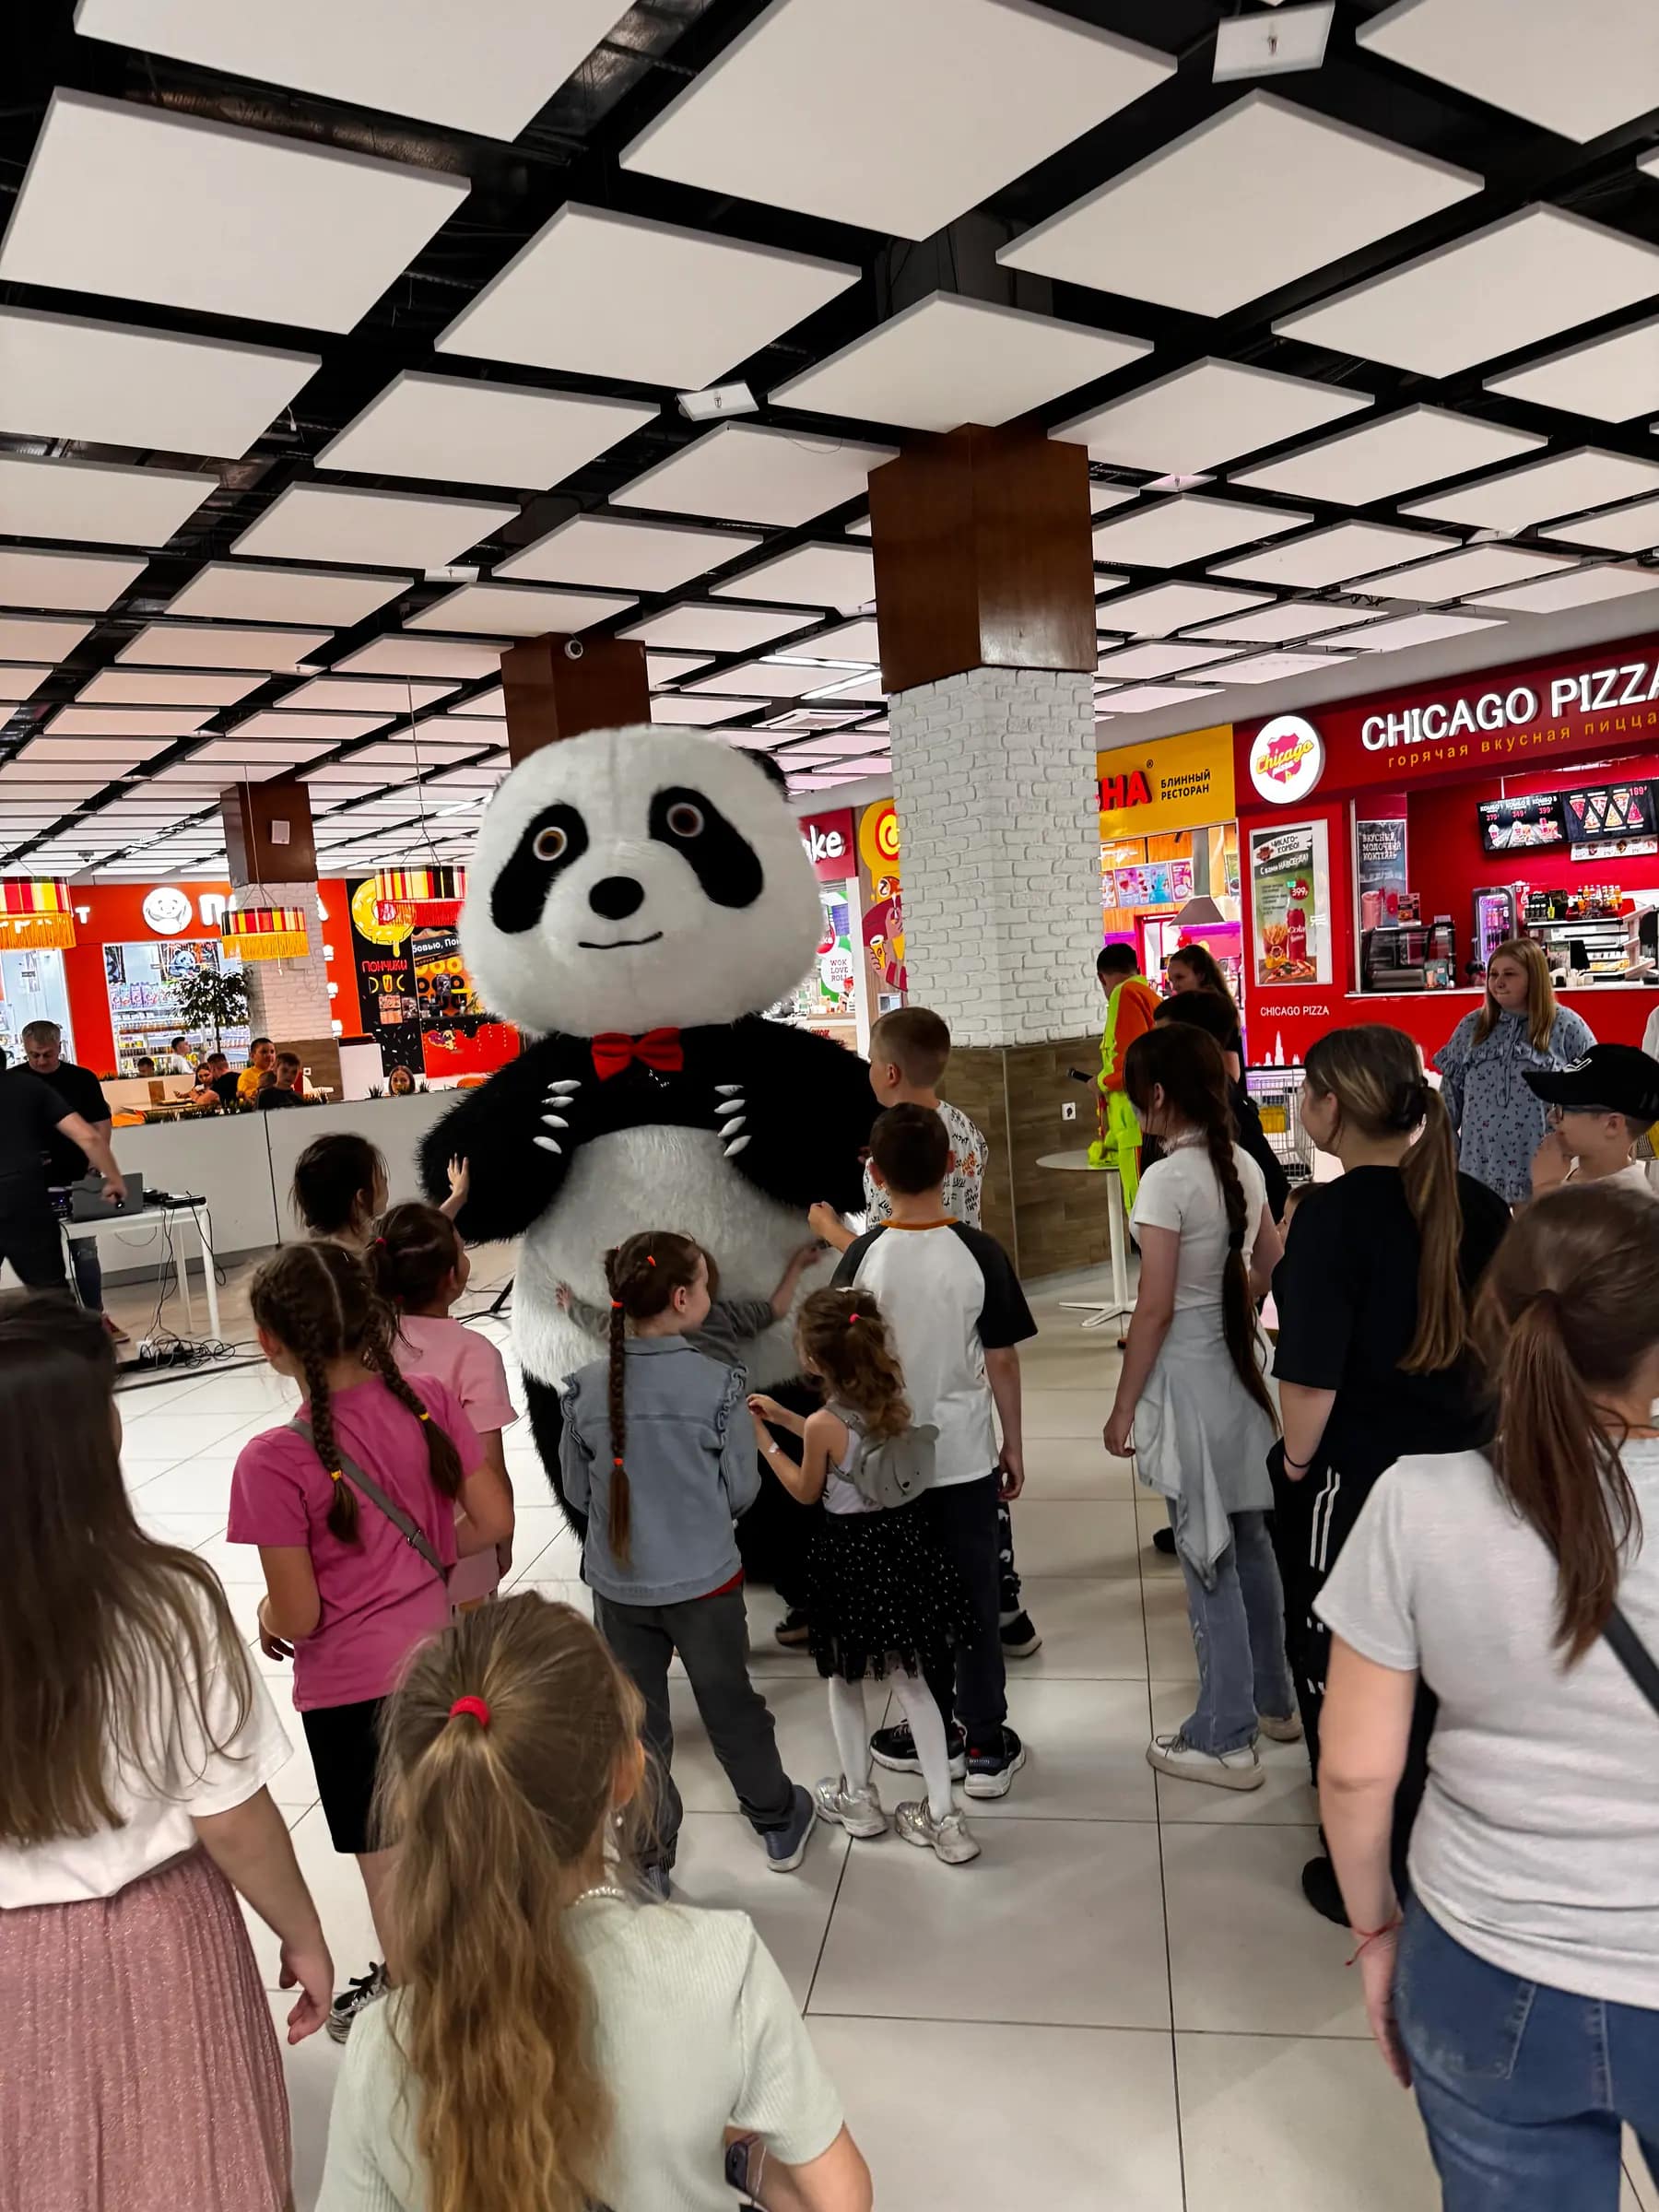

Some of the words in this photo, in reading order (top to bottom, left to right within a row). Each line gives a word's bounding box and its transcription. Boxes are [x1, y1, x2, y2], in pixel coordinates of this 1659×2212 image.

[1361, 687, 1538, 751] CHICAGO
[1255, 739, 1314, 774] Chicago
[1388, 744, 1468, 768] горячая
[1481, 727, 1571, 753] вкусная
[1585, 711, 1658, 736] пицца
[1096, 770, 1152, 811] НА
[1160, 769, 1211, 789] БЛИННЫЙ
[1160, 784, 1209, 801] РЕСТОРАН
[1260, 1006, 1300, 1017] CHICAGO
[1302, 1005, 1330, 1016] PIZZA
